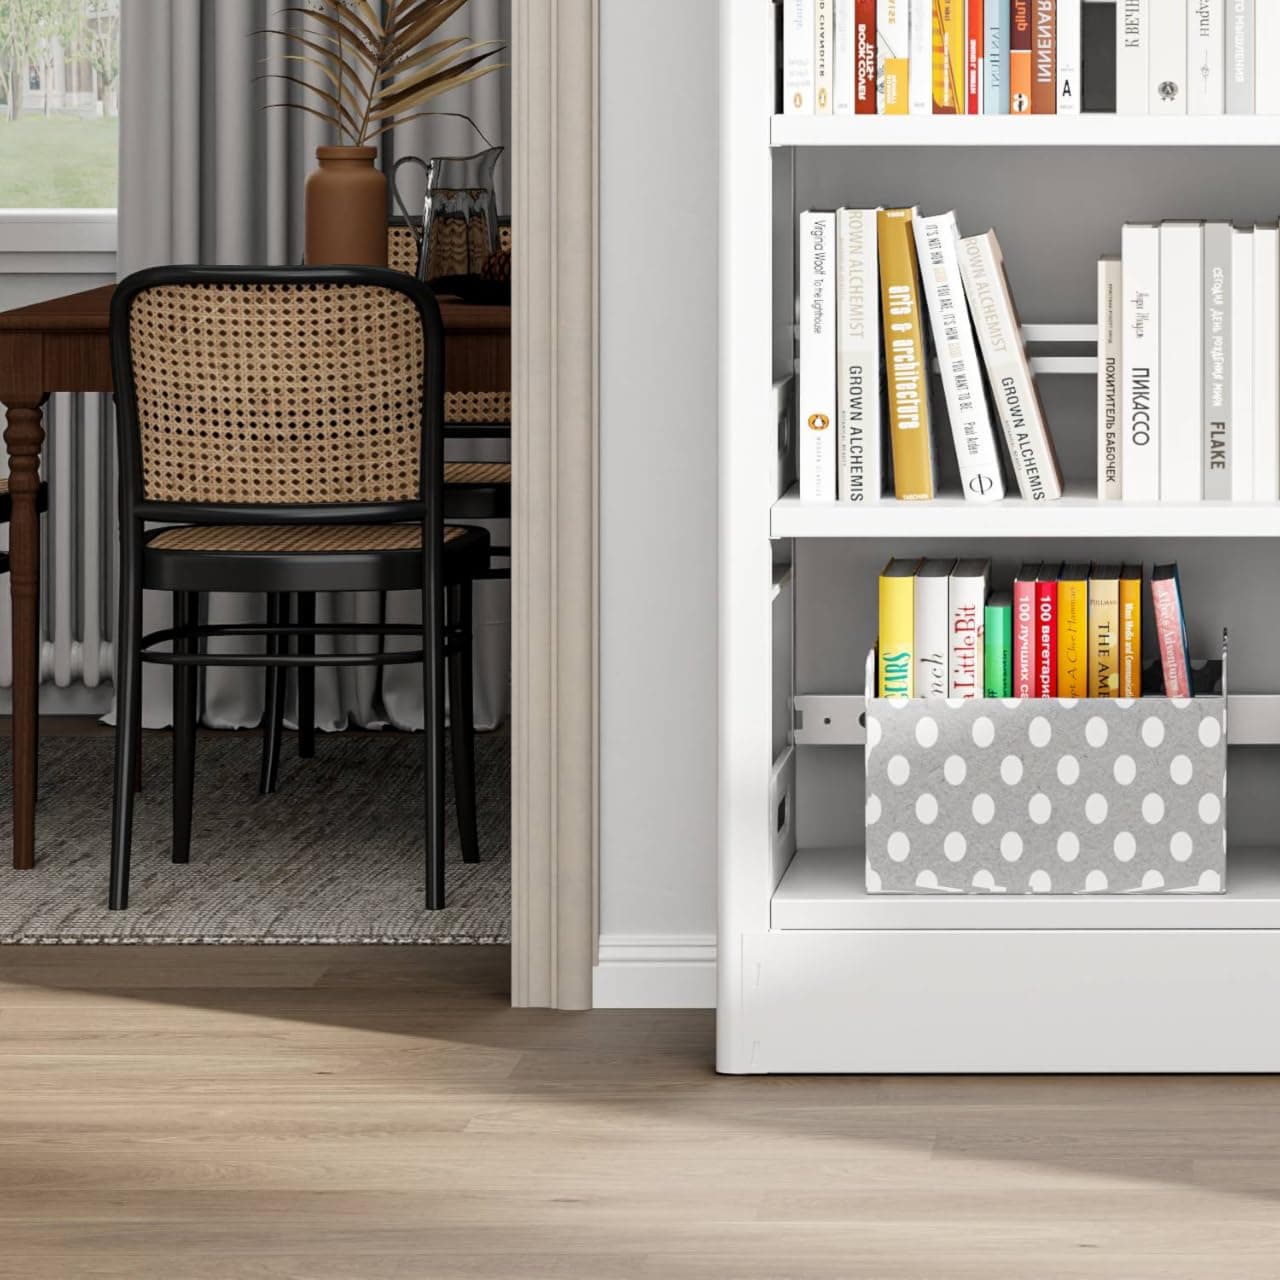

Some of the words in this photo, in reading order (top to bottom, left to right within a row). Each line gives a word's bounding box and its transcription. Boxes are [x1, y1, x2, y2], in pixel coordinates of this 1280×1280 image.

[811, 220, 826, 251] Virginia
[814, 252, 827, 275] Woolf
[850, 366, 863, 420] GROWN
[1001, 377, 1024, 428] GROWN
[1106, 358, 1115, 429] ПОХИТИТЕЛЬ
[1132, 368, 1150, 446] ПИКАССО
[1106, 432, 1116, 482] БАБОЧЕК
[1210, 422, 1225, 470] FLAKE
[954, 604, 976, 633] Bit
[1019, 595, 1029, 622] 100
[1041, 595, 1051, 622] 100
[954, 636, 976, 689] Little
[1017, 624, 1030, 680] лучших
[1098, 622, 1110, 657] THE
